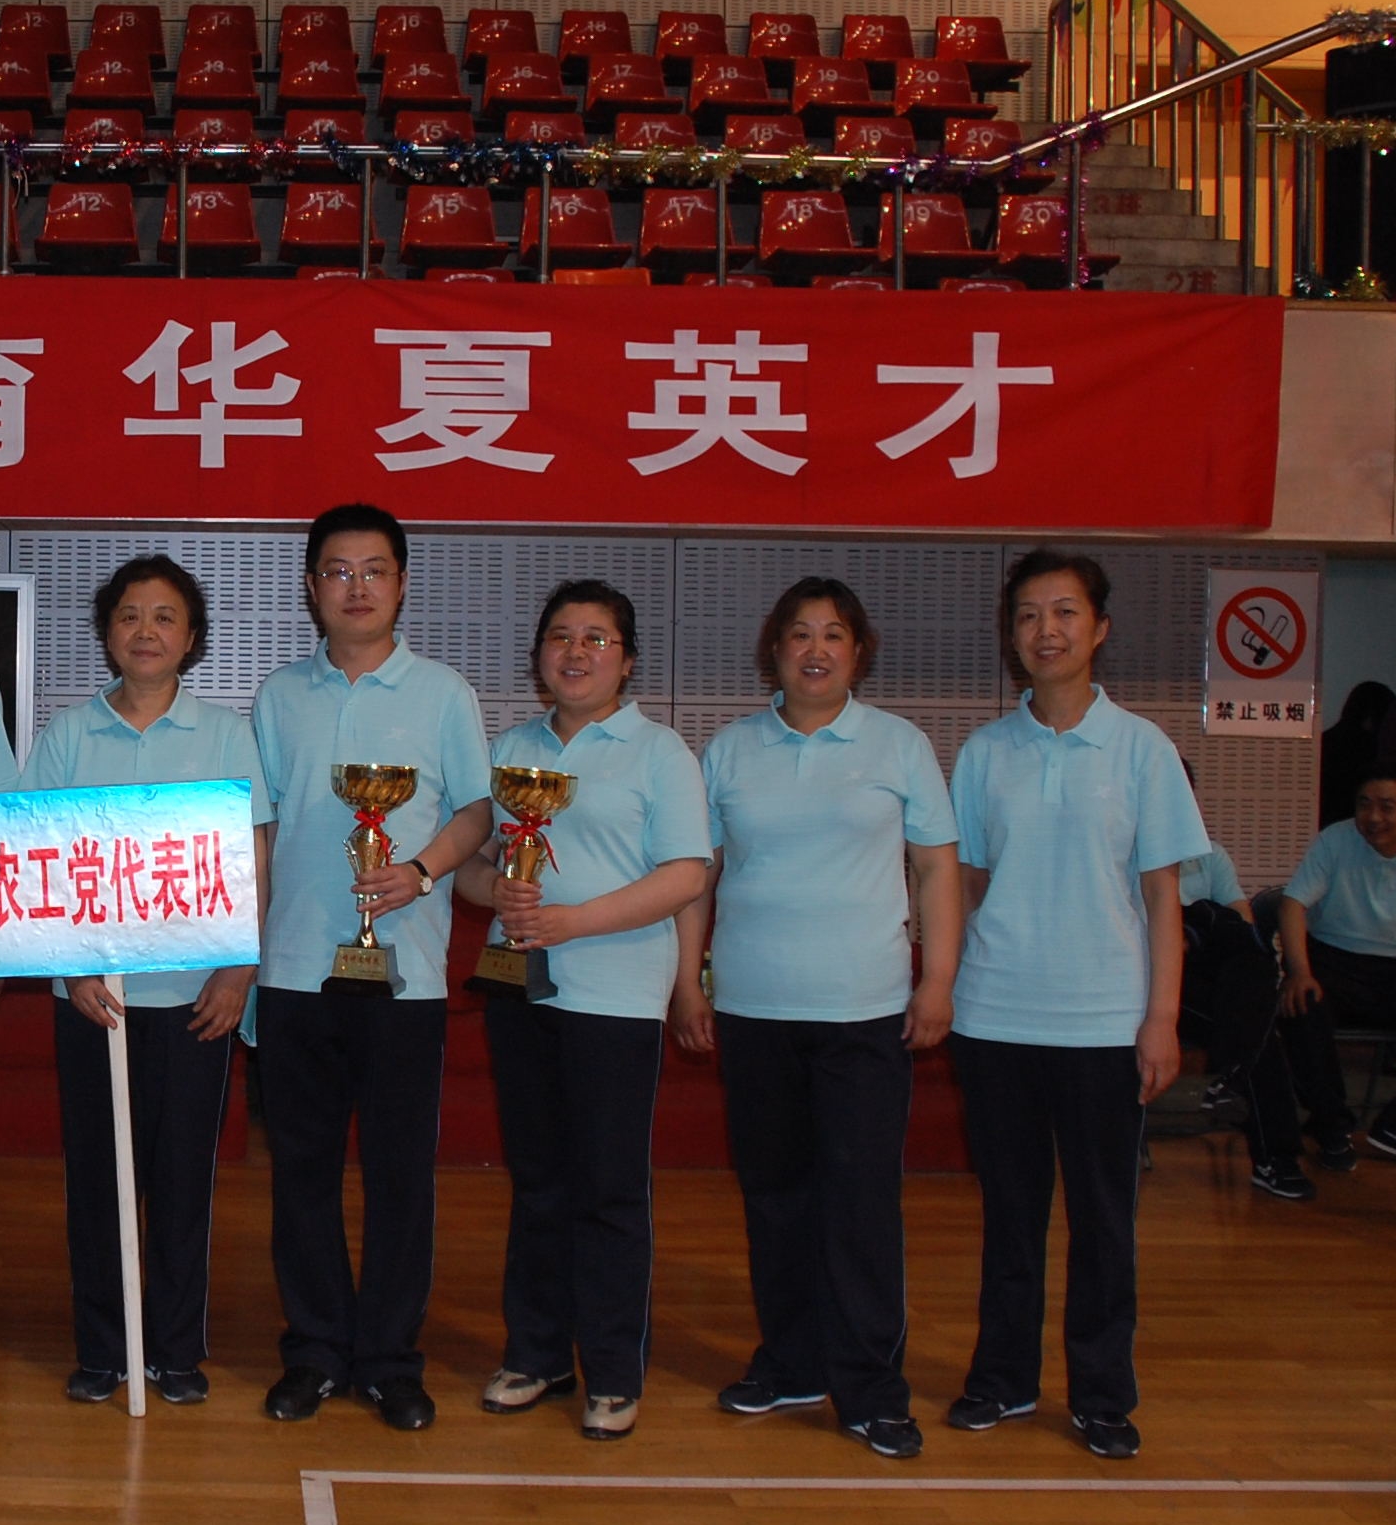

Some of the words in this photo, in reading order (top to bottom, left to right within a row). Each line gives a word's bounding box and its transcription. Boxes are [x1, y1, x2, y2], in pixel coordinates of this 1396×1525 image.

[26, 14, 41, 27] 12
[118, 13, 135, 26] 13
[214, 14, 231, 26] 14
[306, 14, 324, 27] 15
[402, 15, 420, 28] 16
[493, 20, 509, 30] 17
[682, 22, 699, 33] 19
[768, 23, 792, 35] 20
[866, 25, 885, 37] 21
[956, 26, 977, 37] 22
[105, 61, 122, 74] 12
[308, 60, 329, 72] 14
[410, 64, 430, 76] 15
[613, 64, 632, 76] 17
[718, 67, 738, 78] 18
[819, 69, 838, 81] 19
[916, 70, 939, 82] 20
[202, 120, 222, 134] 13
[422, 125, 442, 138] 15
[531, 125, 552, 138] 16
[642, 124, 662, 138] 17
[753, 128, 773, 142] 18
[861, 129, 881, 143] 19
[966, 131, 994, 143] 20
[81, 196, 100, 211] 12
[197, 195, 217, 209] 13
[319, 195, 342, 210] 14
[438, 200, 460, 214] 15
[555, 201, 578, 215] 16
[673, 202, 695, 217] 17
[791, 204, 813, 218] 18
[908, 206, 930, 221] 19
[1022, 207, 1051, 221] 20
[1216, 701, 1305, 722] 禁止吸烟
